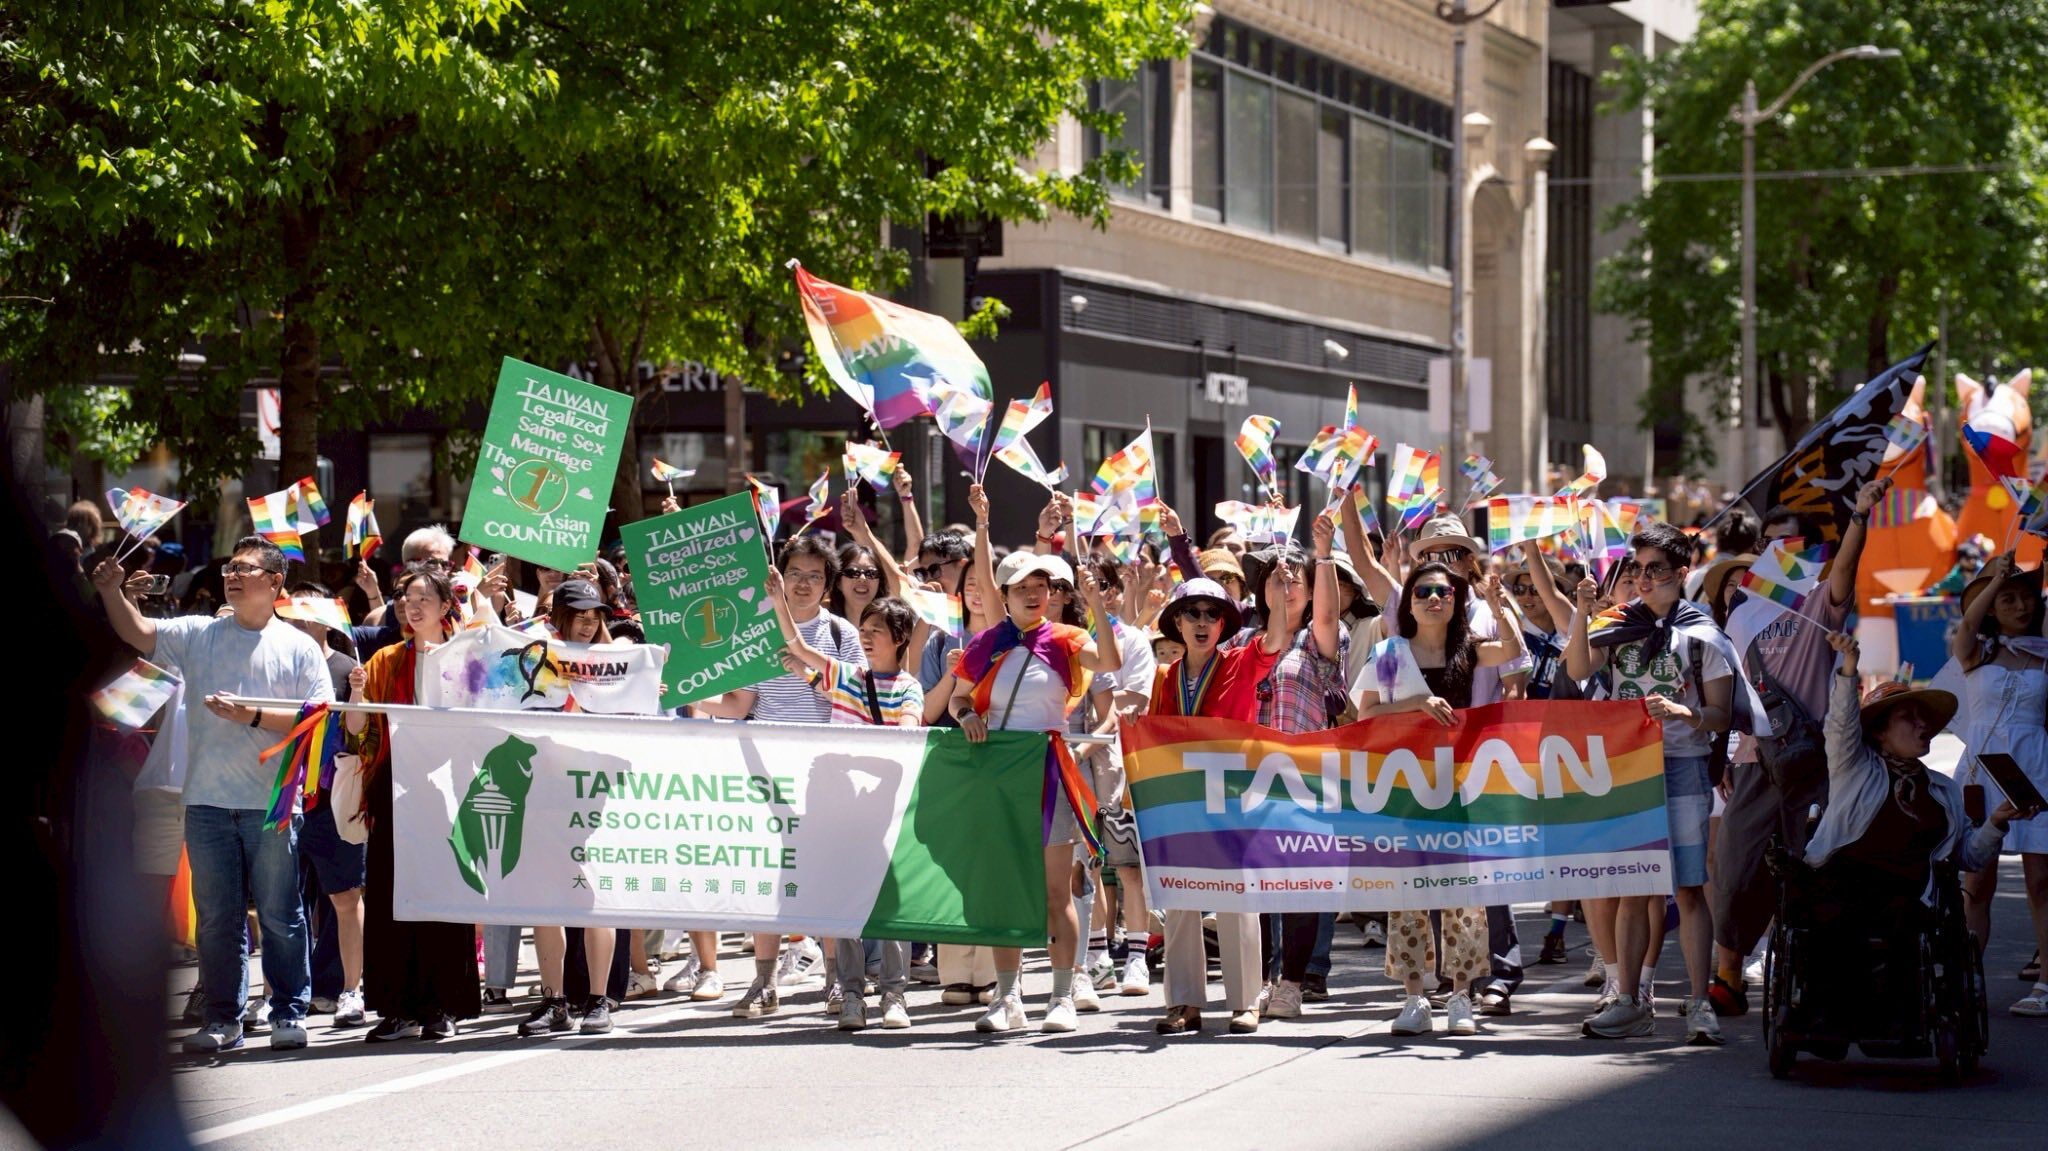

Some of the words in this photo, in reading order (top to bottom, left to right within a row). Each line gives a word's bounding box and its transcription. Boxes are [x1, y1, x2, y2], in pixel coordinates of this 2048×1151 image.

[525, 377, 609, 417] TAIWAN
[523, 397, 608, 437] Legalized
[518, 415, 568, 443] Same
[572, 433, 606, 456] Sex
[485, 442, 517, 469] The
[510, 432, 593, 473] Marriage
[484, 520, 588, 549] COUNTRY!
[539, 512, 590, 533] Asian
[645, 510, 737, 548] TAIWAN
[645, 528, 737, 568] Legalized
[647, 551, 738, 586] Same-Sex
[668, 567, 749, 600] Marriage
[645, 608, 682, 626] The
[731, 618, 776, 651] Asian
[557, 660, 629, 677] TAIWAN
[677, 638, 772, 695] COUNTRY!
[566, 770, 797, 805] TAIWANESE
[1183, 735, 1613, 815] TAIWAN
[569, 811, 753, 833] ASSOCIATION
[766, 816, 800, 834] OF
[1275, 834, 1367, 853] WAVES
[1374, 834, 1408, 853] OF
[1415, 824, 1540, 851] WONDER
[570, 846, 668, 865] GREATER
[675, 843, 797, 870] SEATTLE
[572, 874, 799, 898] 大西雅圖台灣同鄉會
[1159, 876, 1246, 895] Welcoming
[1259, 879, 1334, 892] Inclusive
[1351, 877, 1395, 892] Open
[1413, 873, 1479, 889] Diverse
[1493, 868, 1545, 883] Proud
[1559, 861, 1662, 880] Progressive
